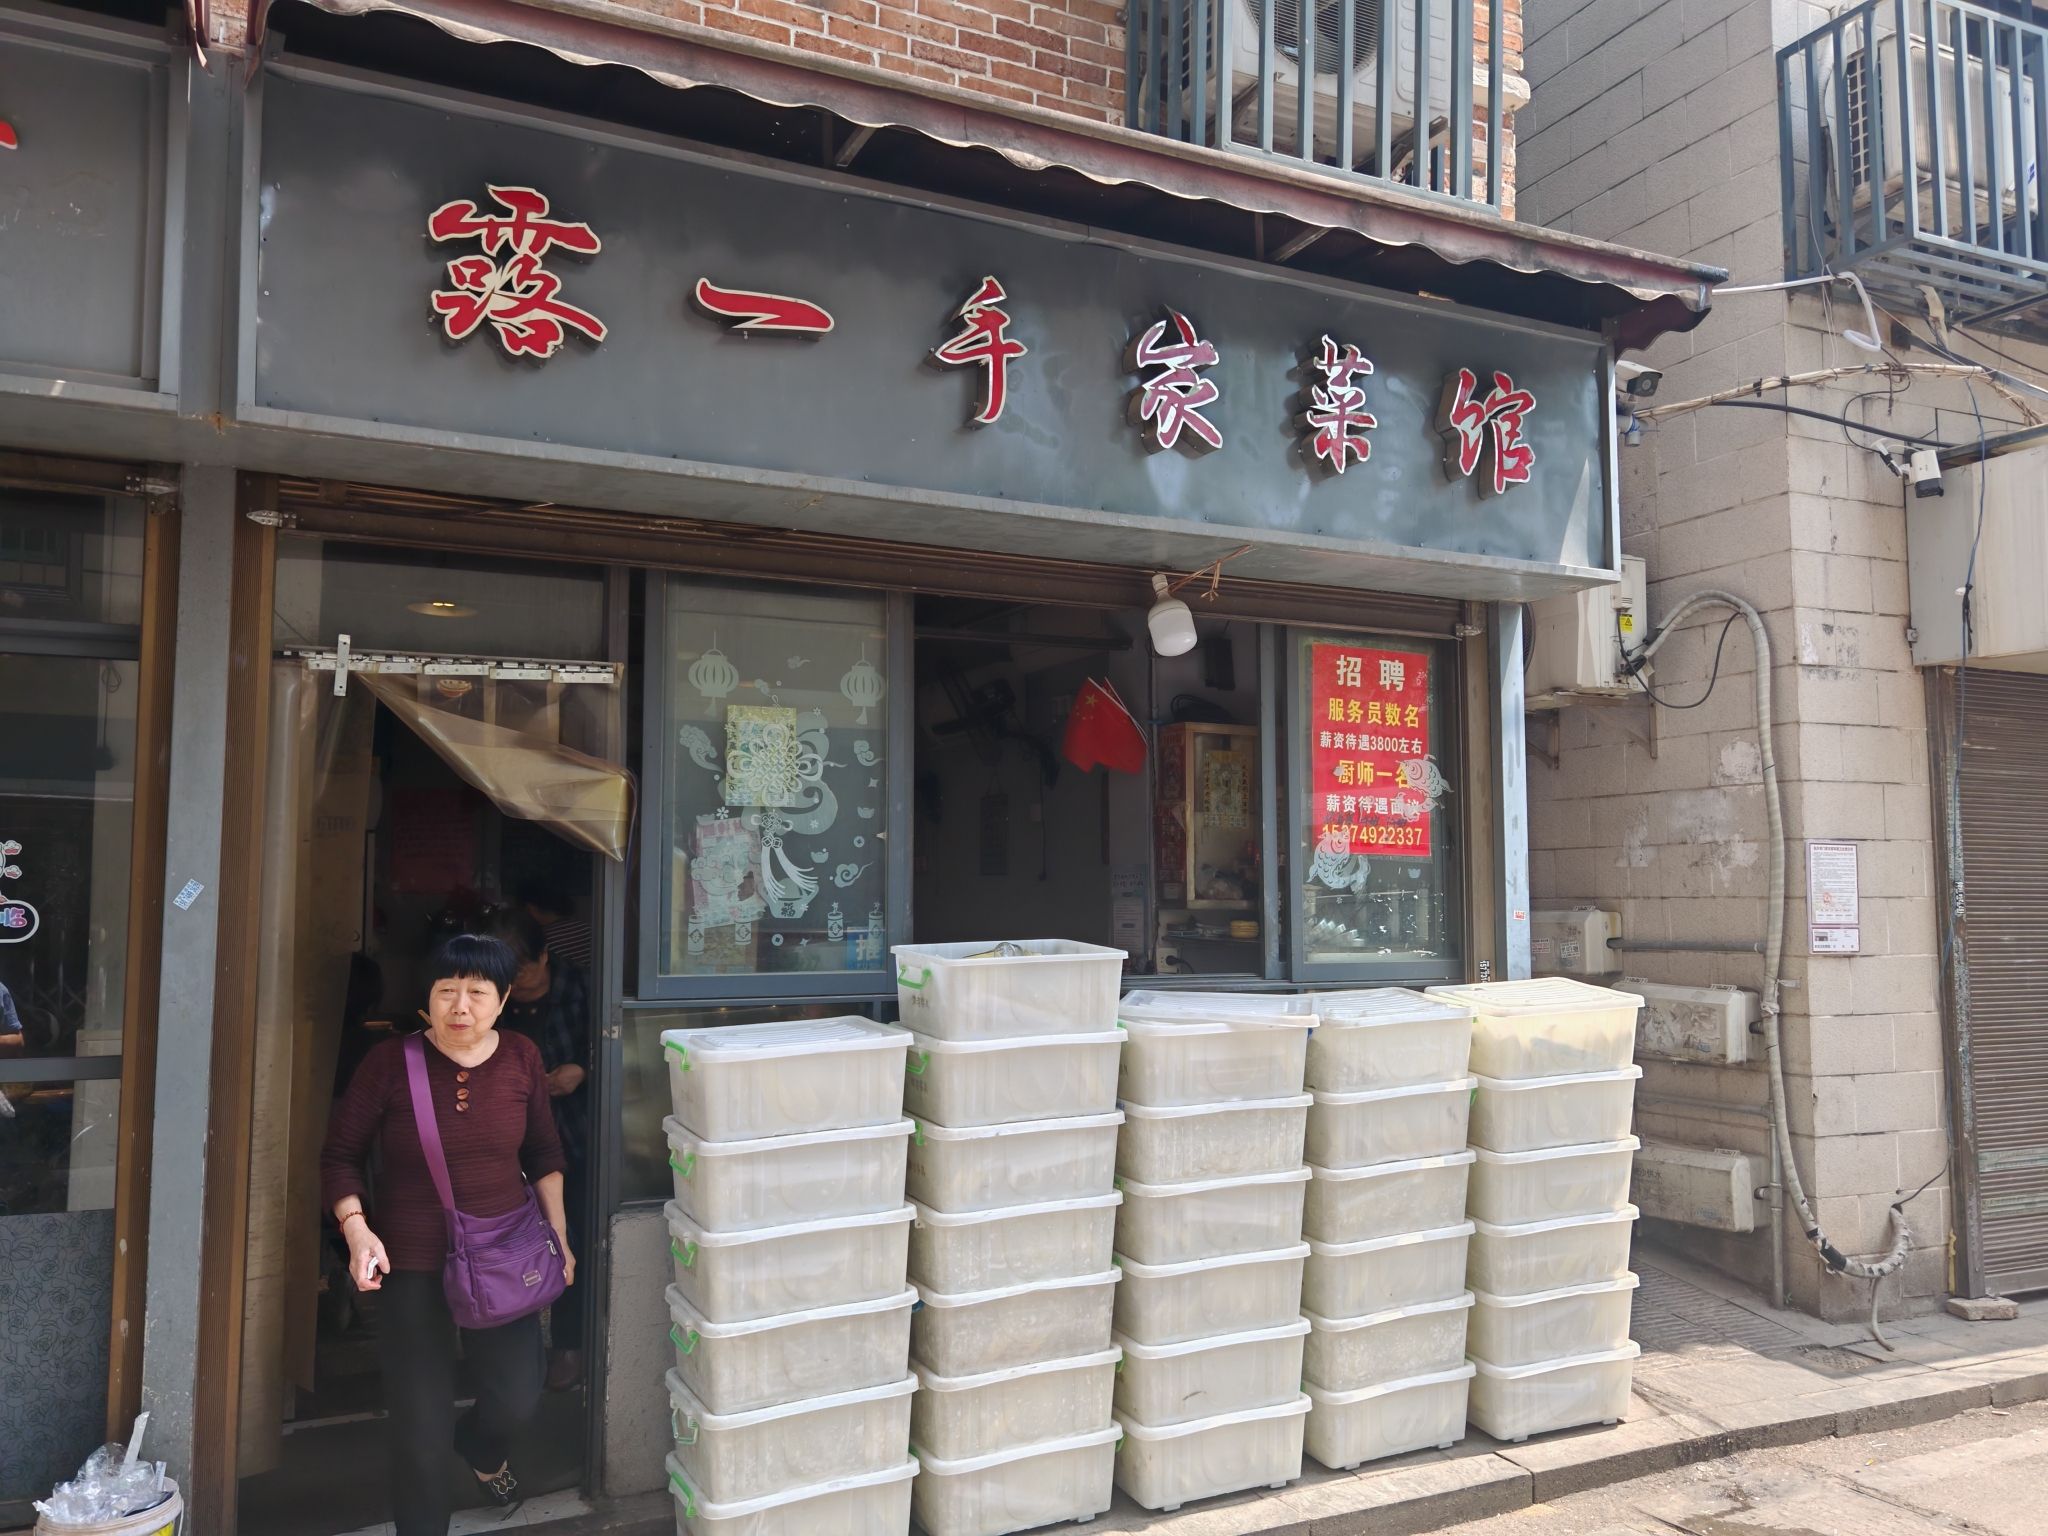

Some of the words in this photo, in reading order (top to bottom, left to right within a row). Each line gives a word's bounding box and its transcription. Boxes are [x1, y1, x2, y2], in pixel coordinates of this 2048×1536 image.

[427, 184, 1537, 495] 露一手家菜馆
[1336, 654, 1406, 692] 招聘
[1328, 697, 1420, 729] 服务员数名
[1320, 731, 1423, 754] 薪资待遇3800左右
